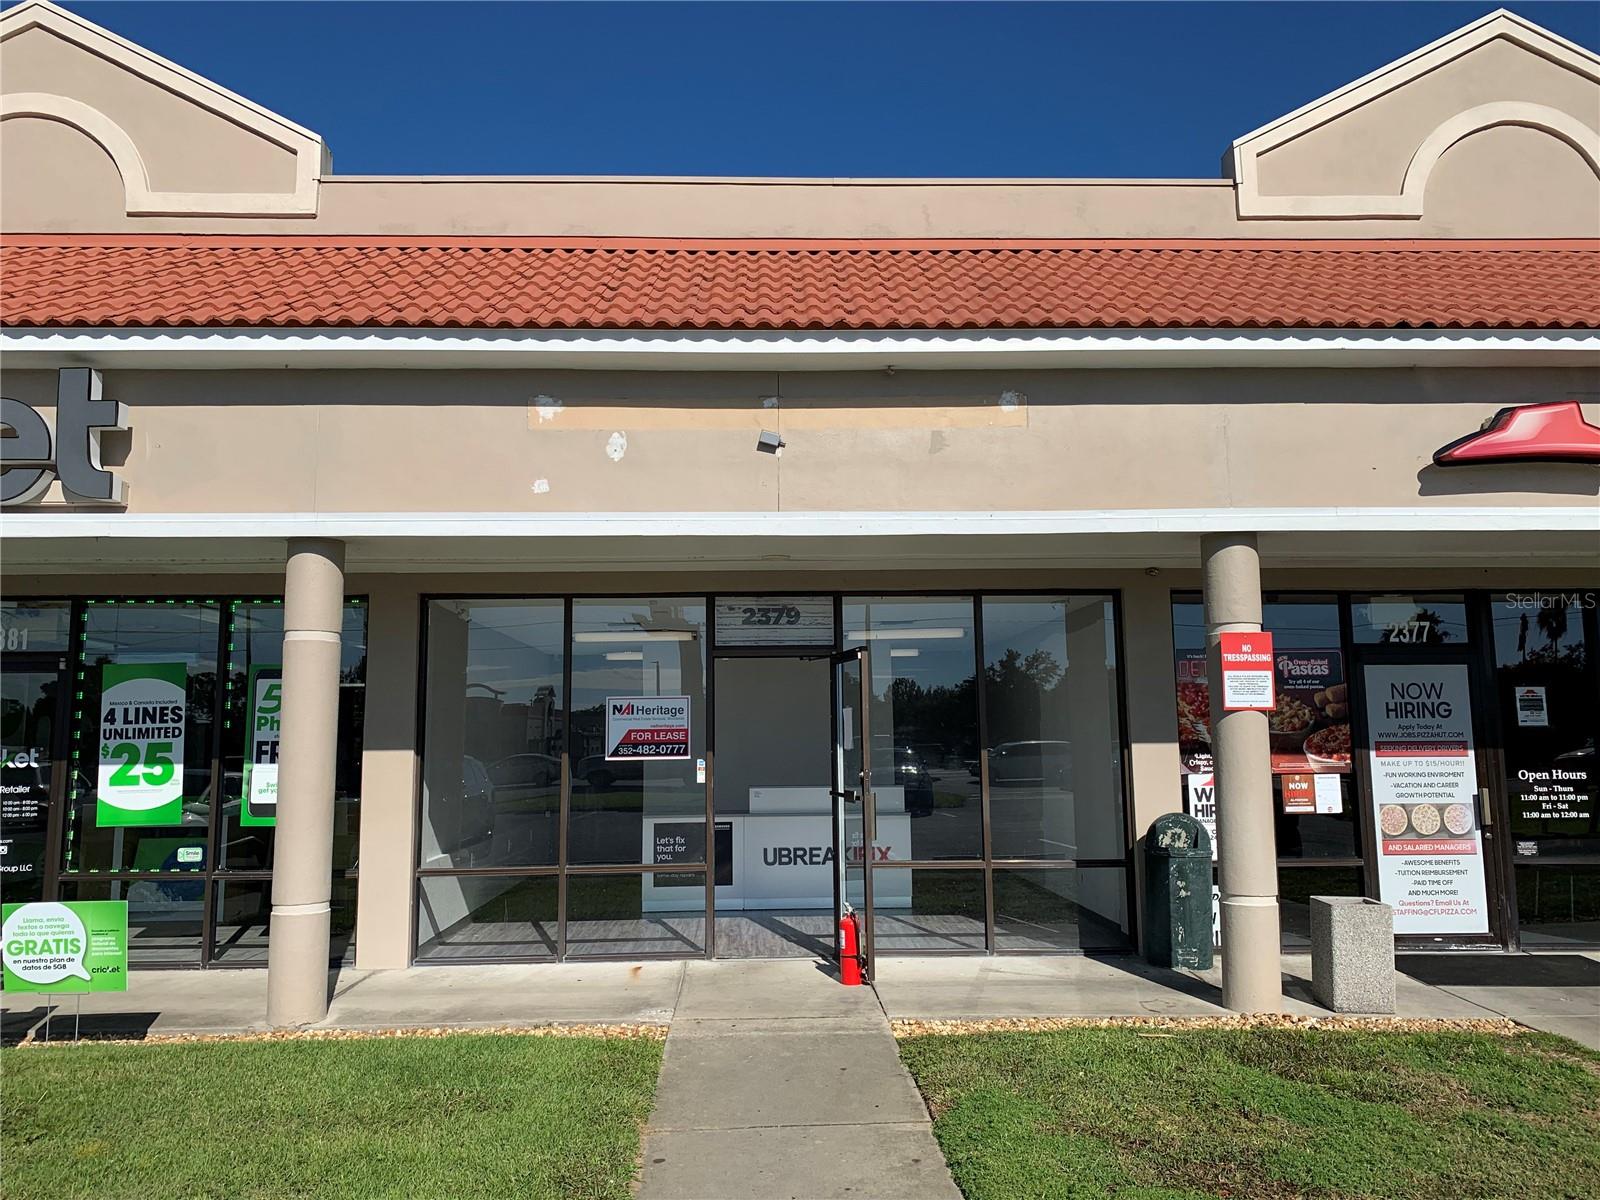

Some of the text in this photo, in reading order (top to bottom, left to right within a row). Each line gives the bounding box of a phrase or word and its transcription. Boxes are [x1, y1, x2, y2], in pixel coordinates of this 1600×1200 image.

[742, 606, 800, 625] 2379
[1389, 621, 1430, 643] 2377
[1241, 644, 1252, 652] NO
[1223, 654, 1272, 662] TRESSPASSING
[1278, 661, 1329, 678] Pastas
[1390, 682, 1444, 700] NOW
[103, 706, 183, 726] 4 LINES
[613, 702, 684, 717] NAI Heritage
[1385, 702, 1452, 719] HIRING
[103, 727, 182, 740] UNLIMITED
[618, 745, 686, 754] 352-482-0777
[1518, 770, 1587, 782] Open Hours
[676, 836, 686, 844] fix
[763, 846, 892, 866] UBREAKIIX
[6, 938, 81, 956] GRATIS
